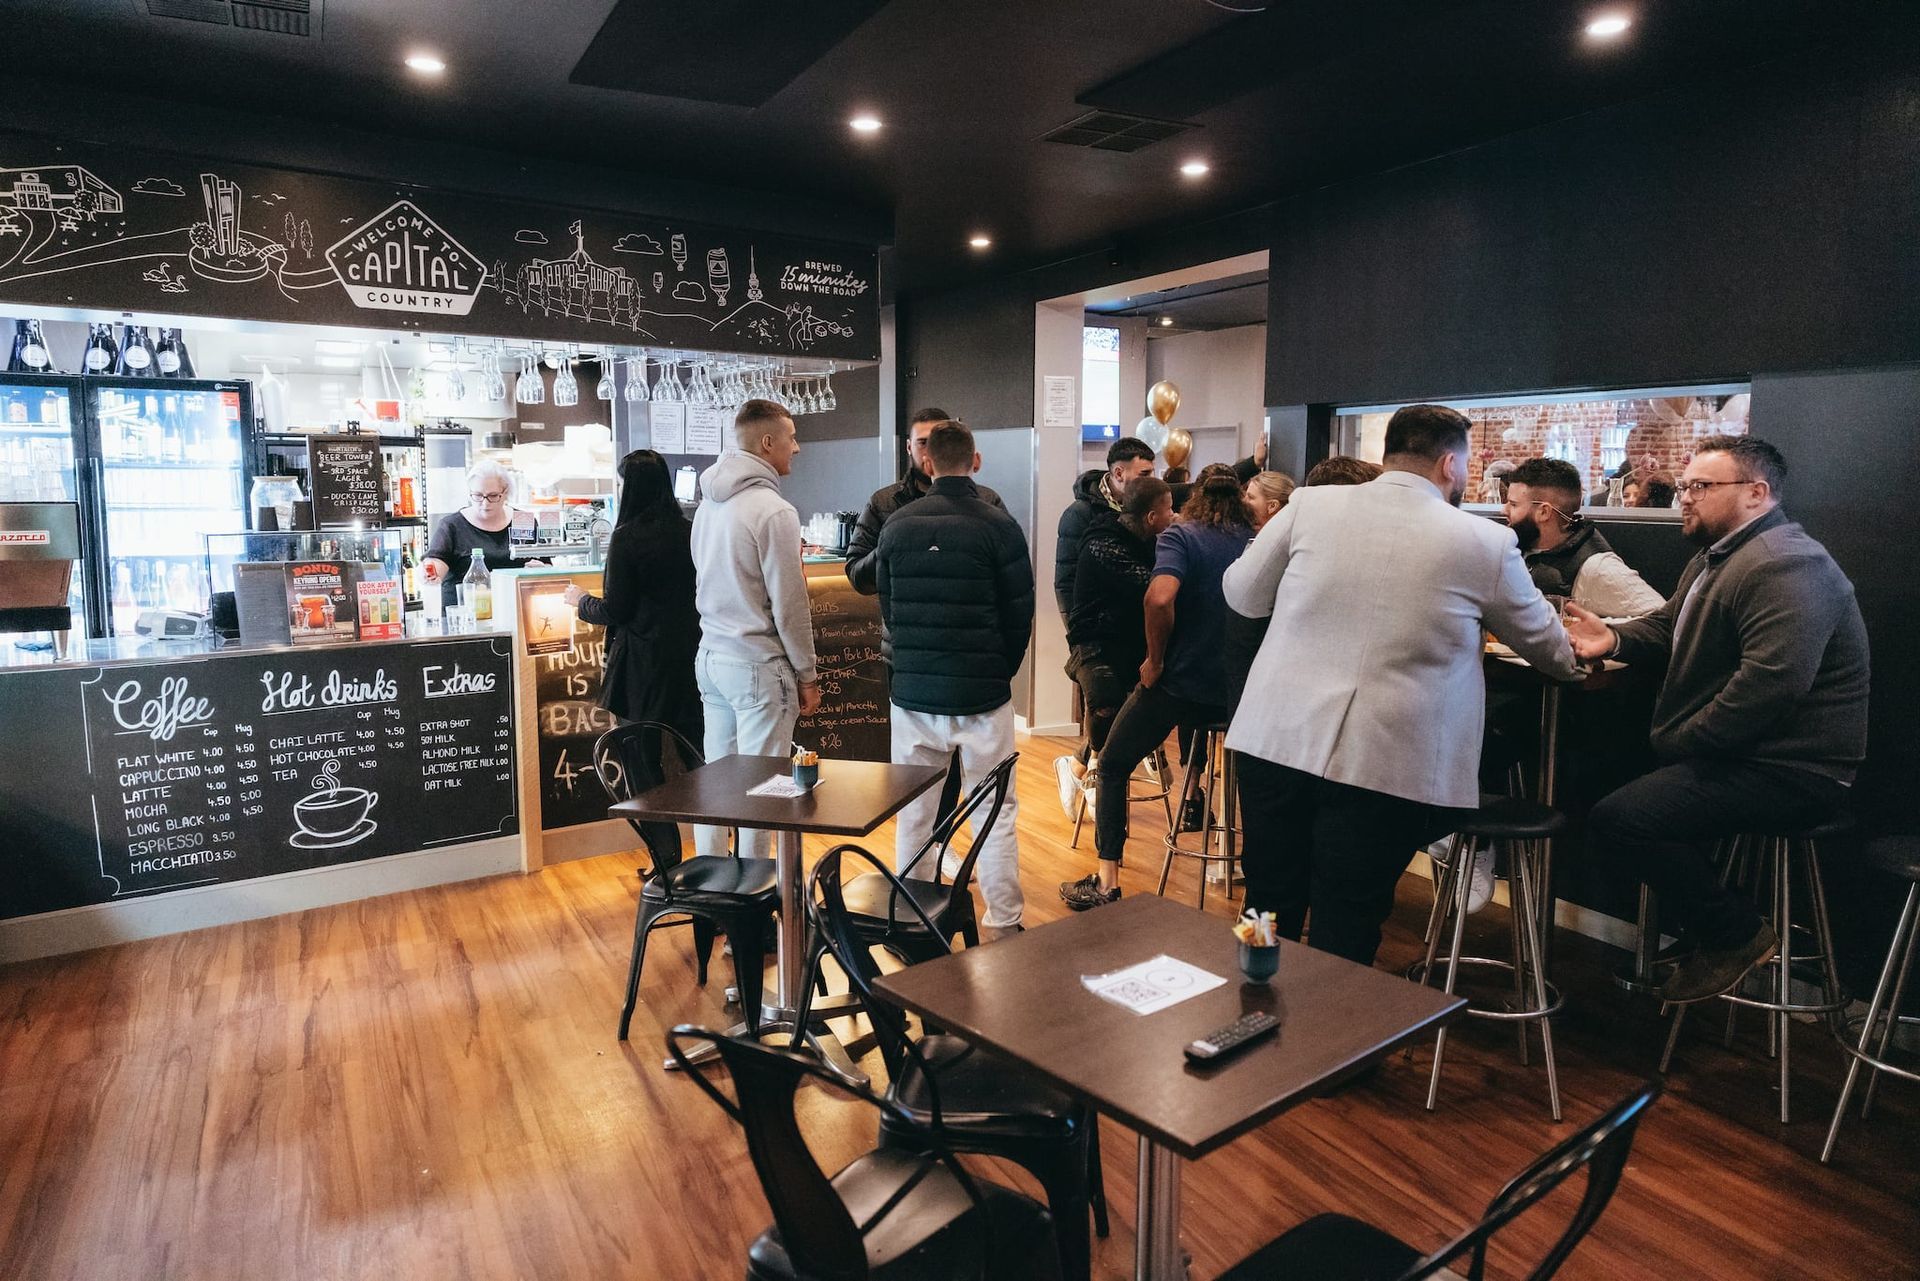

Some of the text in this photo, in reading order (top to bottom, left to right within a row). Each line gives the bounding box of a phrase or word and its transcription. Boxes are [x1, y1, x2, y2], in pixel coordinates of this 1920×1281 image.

[352, 216, 459, 262] WELCOME TO
[348, 231, 469, 290] CAPITAL
[805, 261, 842, 272] BREWED
[780, 265, 868, 294] 15 minutes
[780, 281, 857, 297] DOWN THE ROAD
[367, 292, 453, 308] COUNTRY
[330, 467, 344, 475] 3RD
[293, 564, 340, 577] BONUS
[843, 647, 862, 662] Pork
[422, 663, 496, 697] Extras
[567, 673, 588, 696] IS
[260, 671, 315, 712] Hot
[102, 676, 215, 741] Coffee
[357, 707, 400, 721] Cup Mug
[235, 724, 252, 737] Mug
[420, 720, 448, 732] EXTRA
[449, 719, 471, 729] SHOT
[799, 718, 815, 728] and
[818, 717, 838, 730] Sage
[269, 727, 405, 749] CHAI LATTE 4.00 4.50
[420, 729, 509, 745] SOY MILK 1.00
[820, 732, 842, 750] $26
[117, 743, 255, 769] FLAT WHITE 4.00 4.50
[270, 741, 405, 766] HOT CHOCOLATE 4.00 4.50
[422, 747, 458, 760] ALMOND
[460, 745, 481, 756] MILK
[119, 760, 257, 787] CAPPUCCINO 4.00 4.50
[272, 760, 377, 781] TEA 4.50
[422, 762, 459, 776] LACTOSE
[460, 760, 479, 771] FREE
[480, 758, 495, 768] MILK
[122, 775, 259, 804] LATTE 4.00 4.50
[424, 780, 442, 791] OAT
[444, 778, 462, 788] MILK
[125, 789, 262, 820] MOCHA 4.50 5.00
[126, 805, 263, 837] LONG BLACK 4.00 4.50
[128, 831, 236, 857] ESPRESSO 3.50
[131, 850, 236, 874] MACCHIATO 3.50
